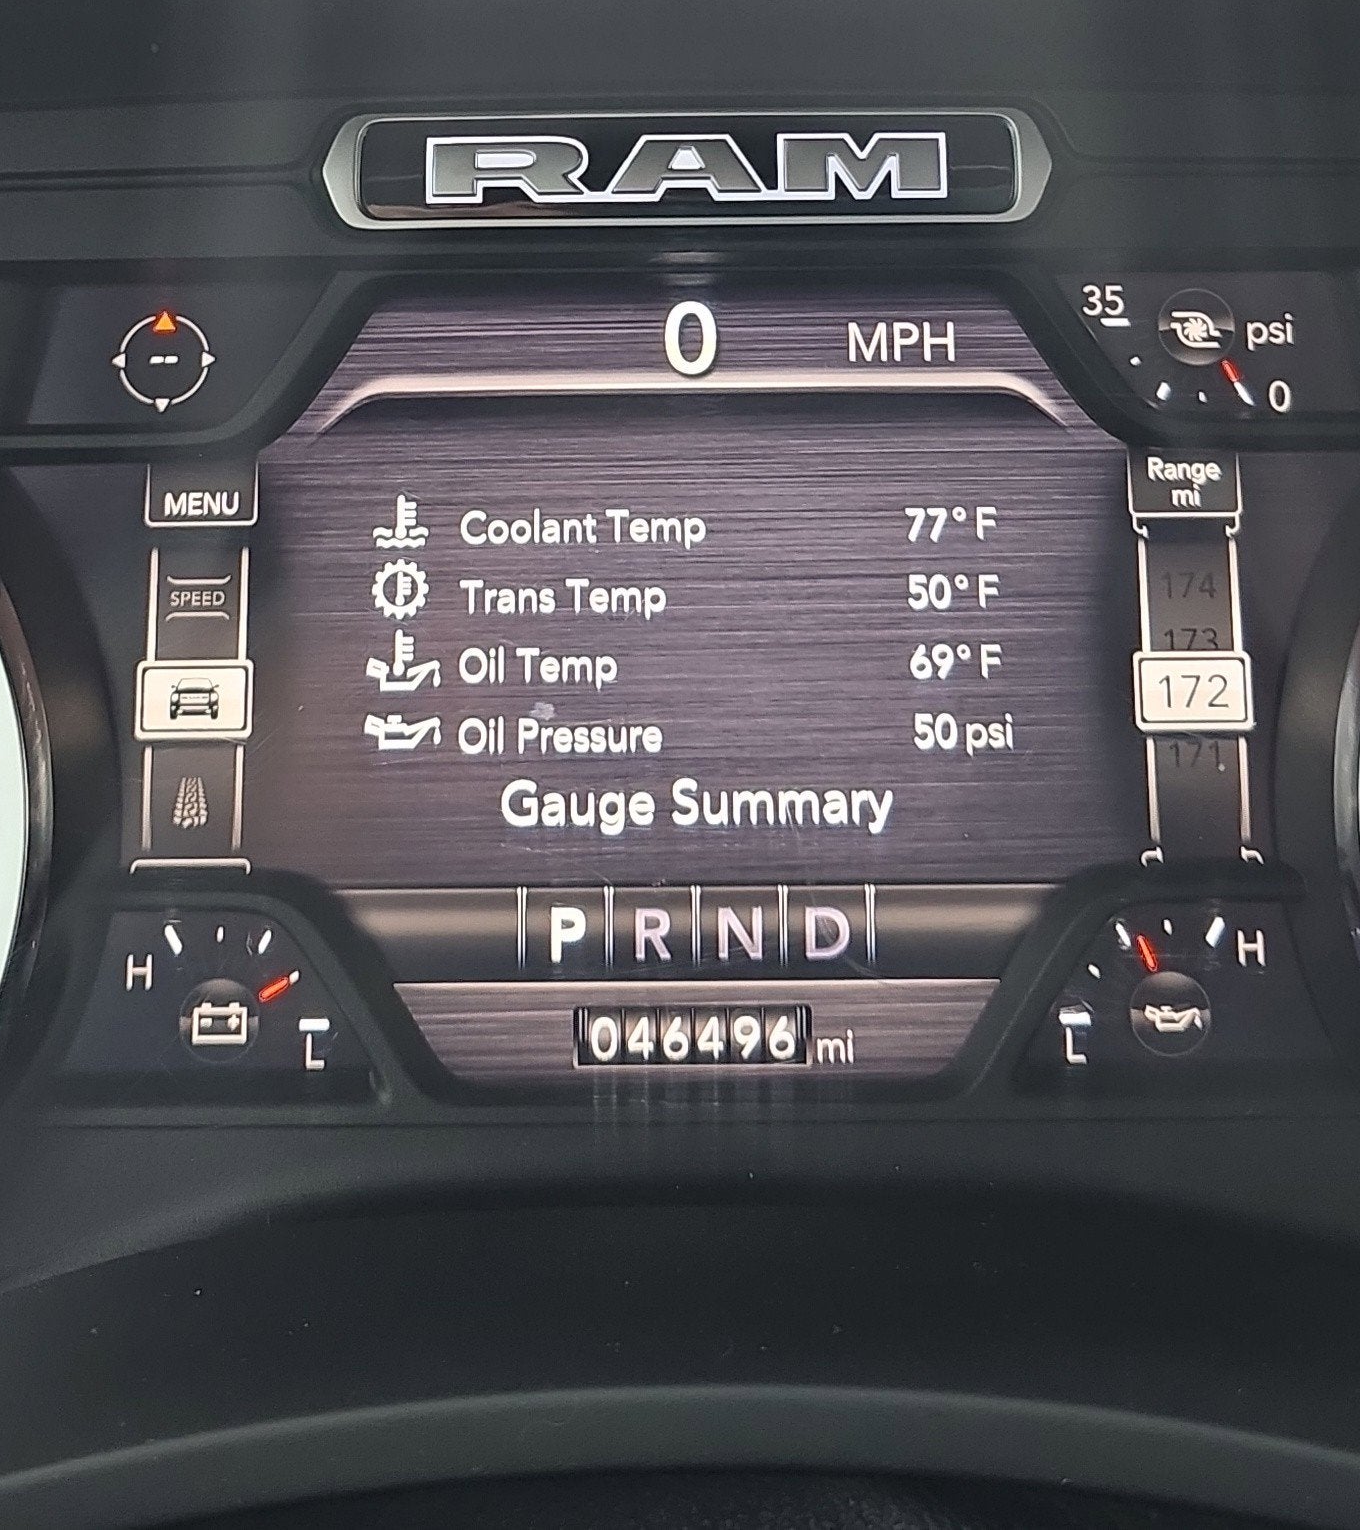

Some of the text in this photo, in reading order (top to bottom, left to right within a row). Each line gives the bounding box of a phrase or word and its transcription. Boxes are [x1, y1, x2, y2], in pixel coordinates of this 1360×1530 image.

[425, 131, 949, 205] RAM
[1082, 284, 1125, 316] 35
[663, 300, 956, 376] 0 MPH
[1246, 313, 1295, 352] psi
[1268, 379, 1292, 413] 0
[1146, 456, 1223, 483] Range
[164, 491, 240, 516] MENU
[1171, 483, 1203, 508] mi
[459, 509, 707, 550] Coolant Temp
[904, 506, 998, 543] 77° F
[170, 591, 225, 608] SPEED
[459, 578, 668, 620] Trans Temp
[907, 573, 1001, 611] 50° F
[458, 647, 619, 691] Oil Temp
[909, 643, 1004, 681] 69° F
[1159, 674, 1230, 709] 172
[458, 716, 663, 755] Oil Pressure
[913, 713, 1014, 757] 50 psi
[500, 779, 894, 835] Gauge Summary
[550, 906, 850, 964] P R N D
[1237, 929, 1266, 967] H
[125, 954, 153, 991] H
[305, 1032, 325, 1070] L
[589, 1015, 855, 1064] 046496 mi
[1065, 1027, 1087, 1064] L
